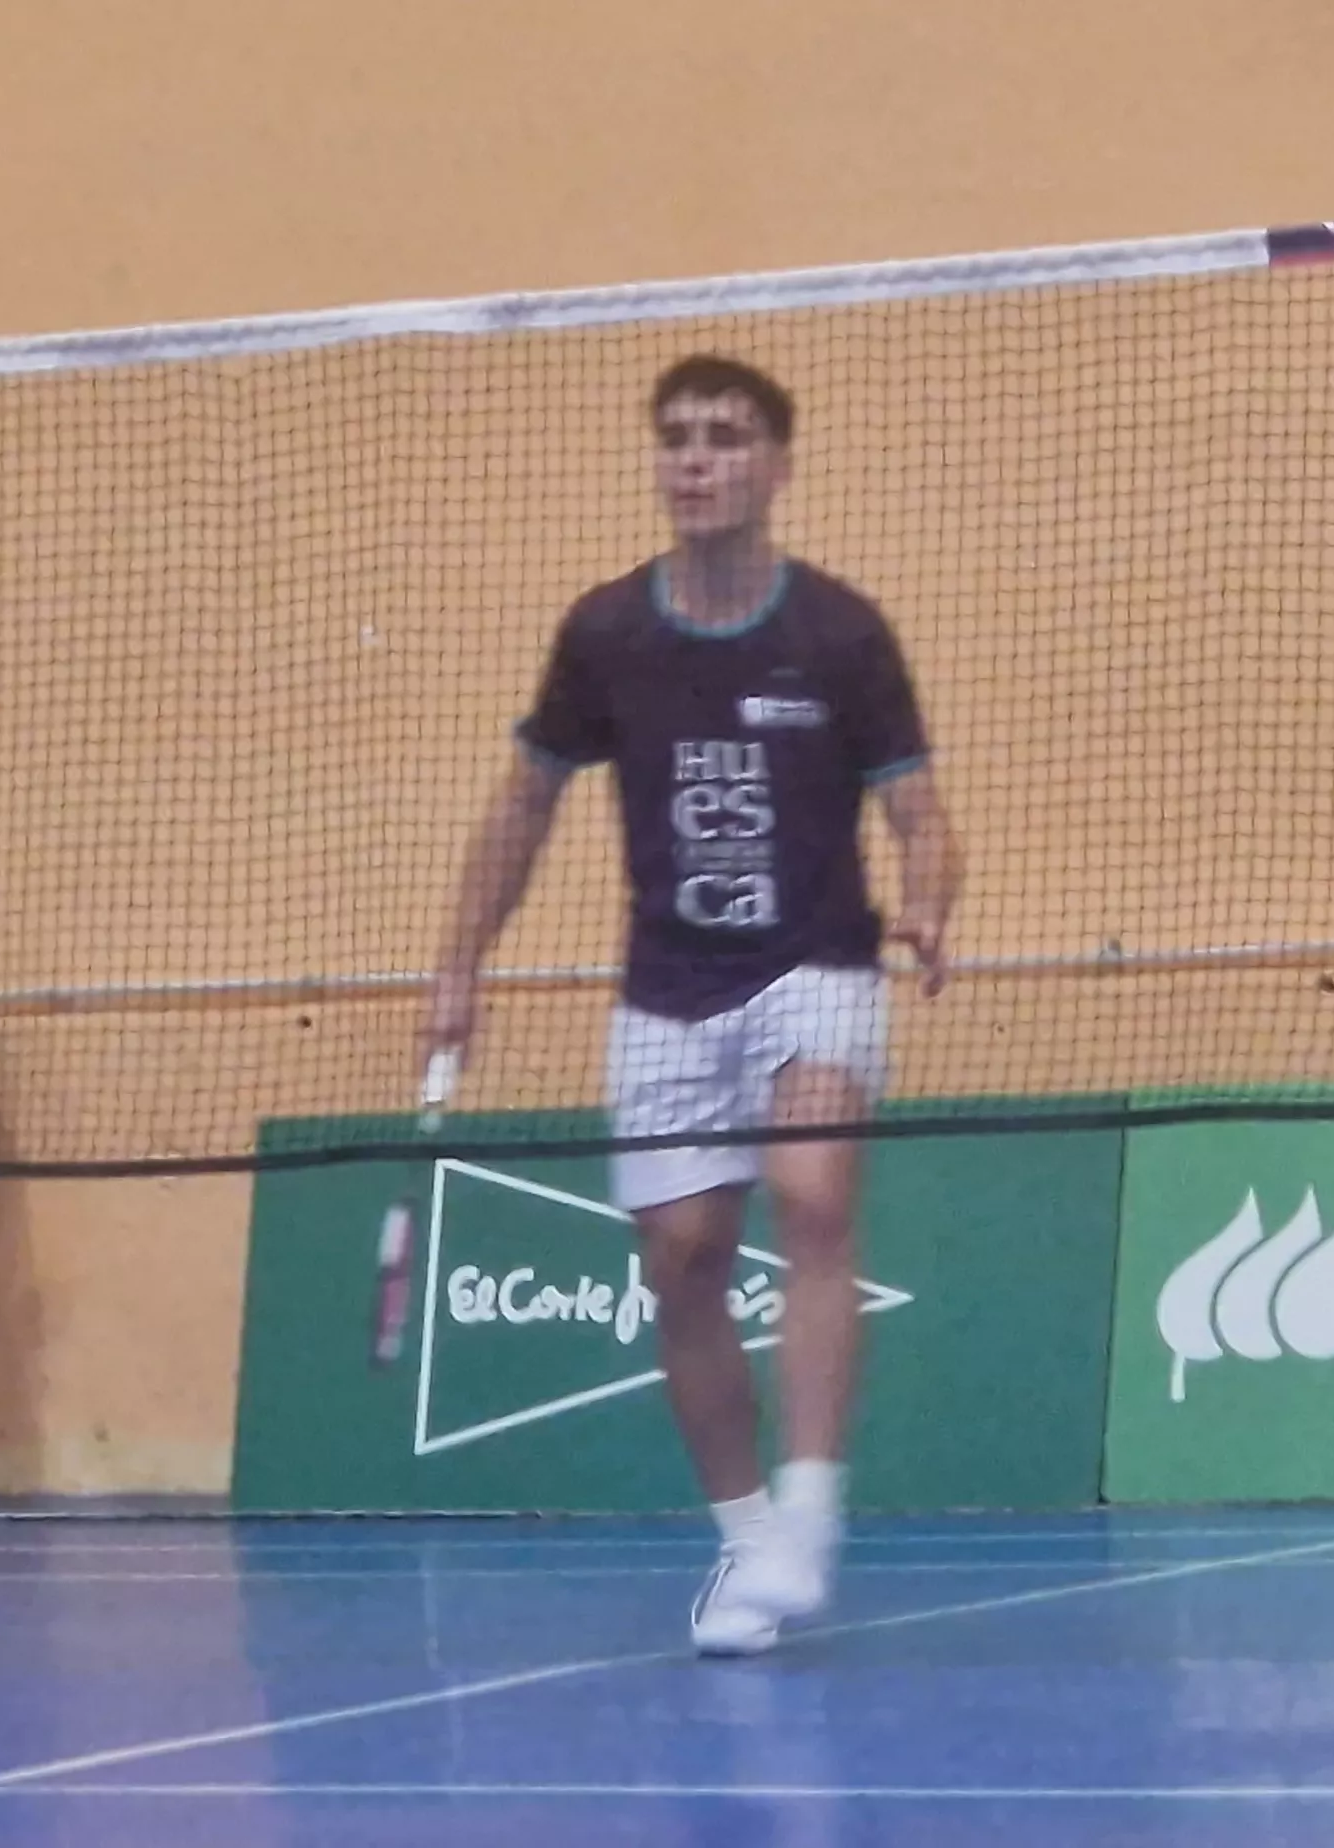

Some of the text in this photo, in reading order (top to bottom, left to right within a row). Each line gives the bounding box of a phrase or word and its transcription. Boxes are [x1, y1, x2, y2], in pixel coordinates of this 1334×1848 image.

[670, 784, 776, 839] es
[674, 873, 780, 927] ca
[448, 1264, 497, 1324] El
[499, 1267, 614, 1324] Corte
